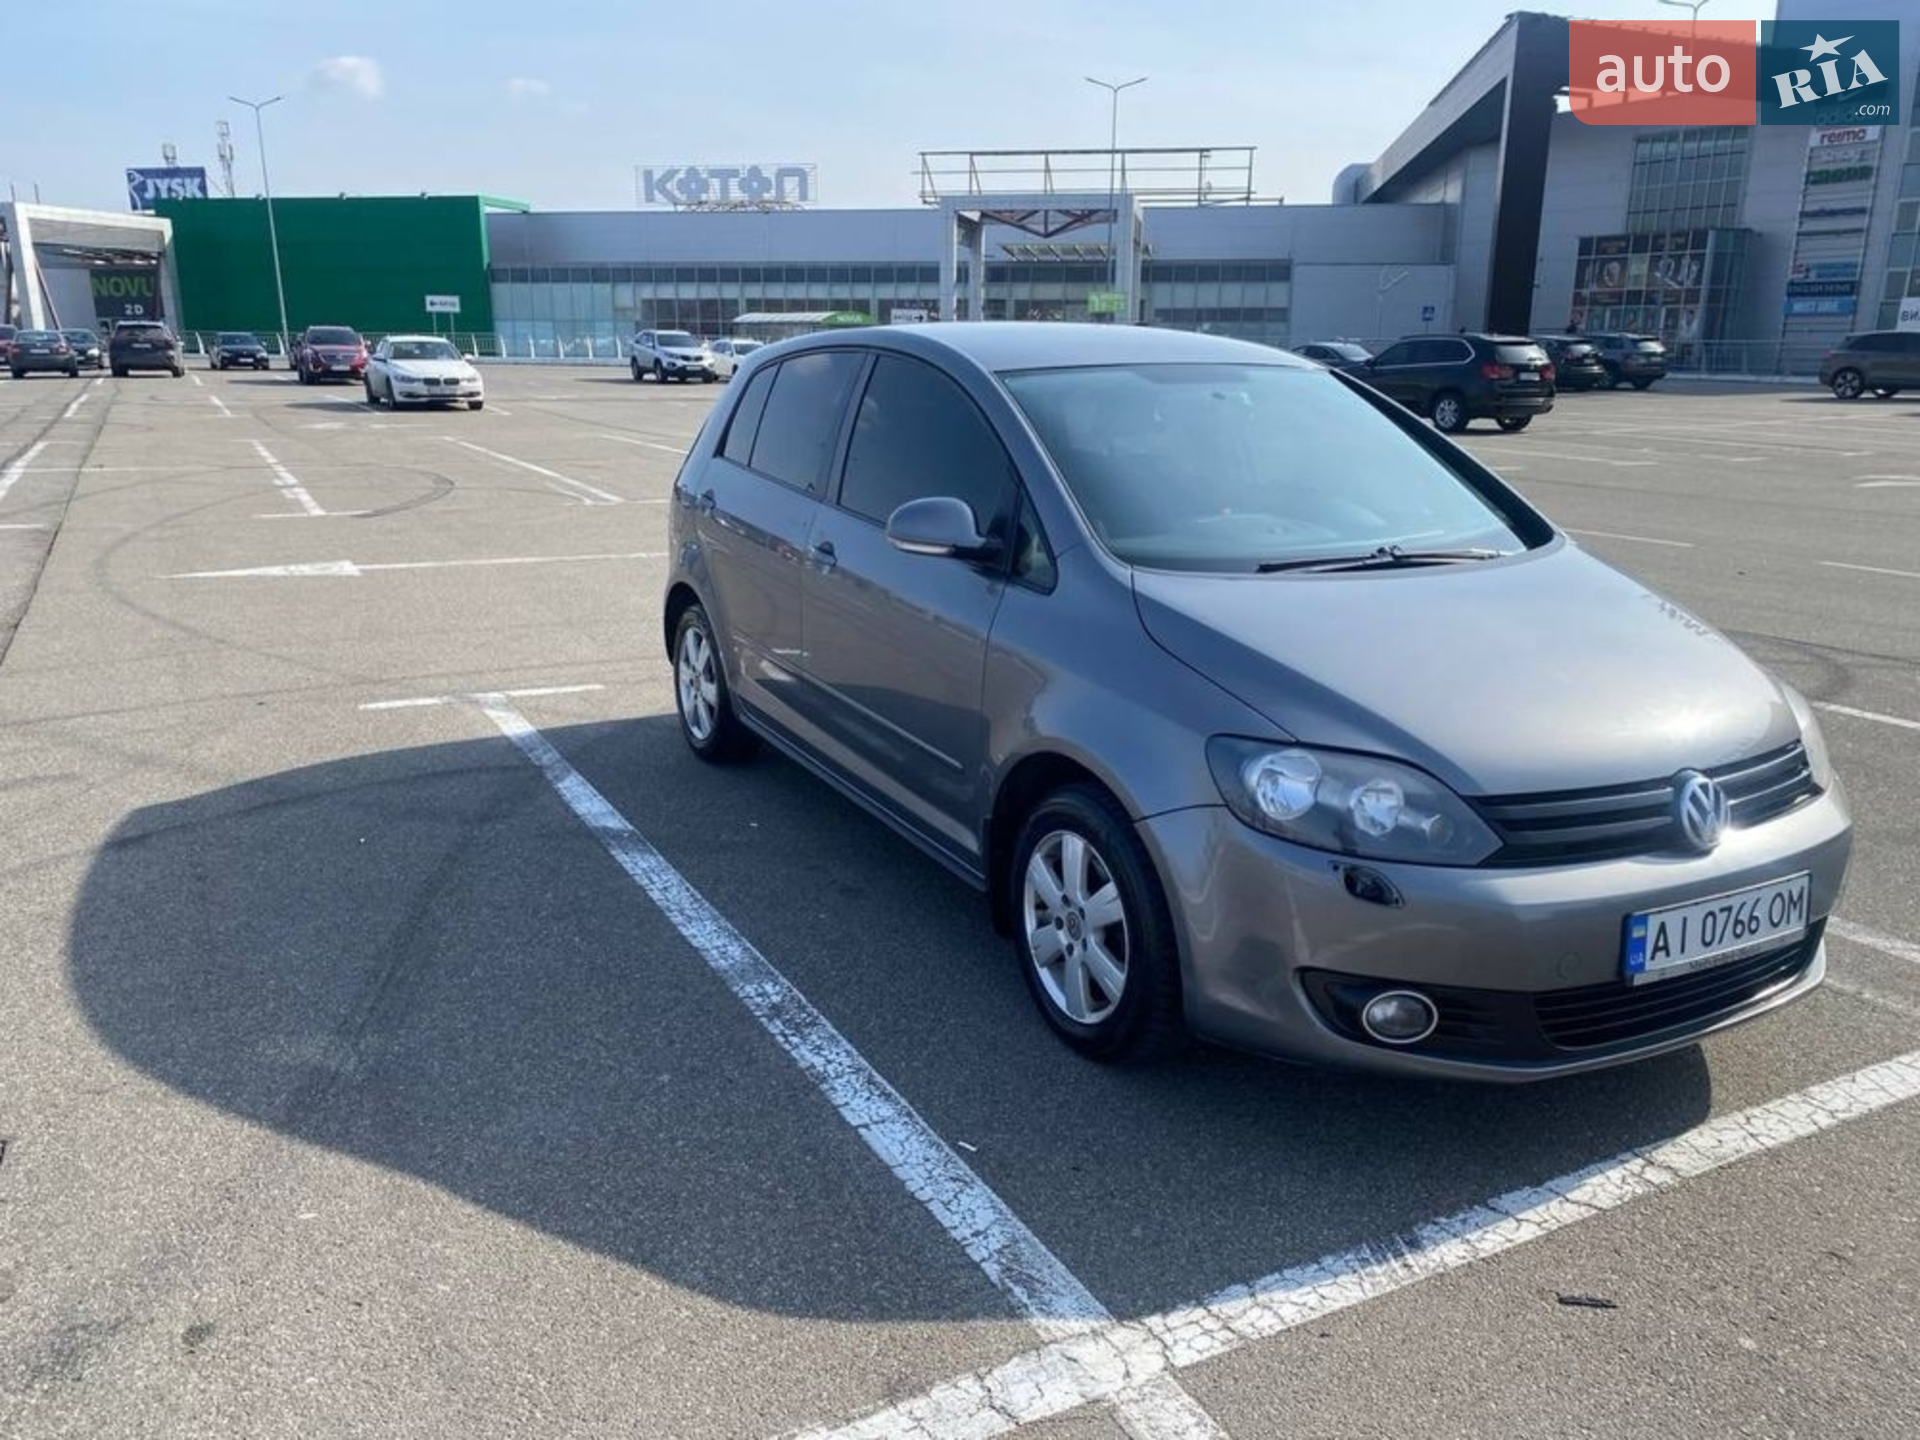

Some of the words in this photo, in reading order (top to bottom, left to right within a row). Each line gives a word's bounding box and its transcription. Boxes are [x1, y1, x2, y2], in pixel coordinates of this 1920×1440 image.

[144, 177, 203, 199] JYSK
[1650, 916, 1687, 961] AI
[1702, 899, 1760, 947] 0766
[1768, 886, 1805, 928] OM
